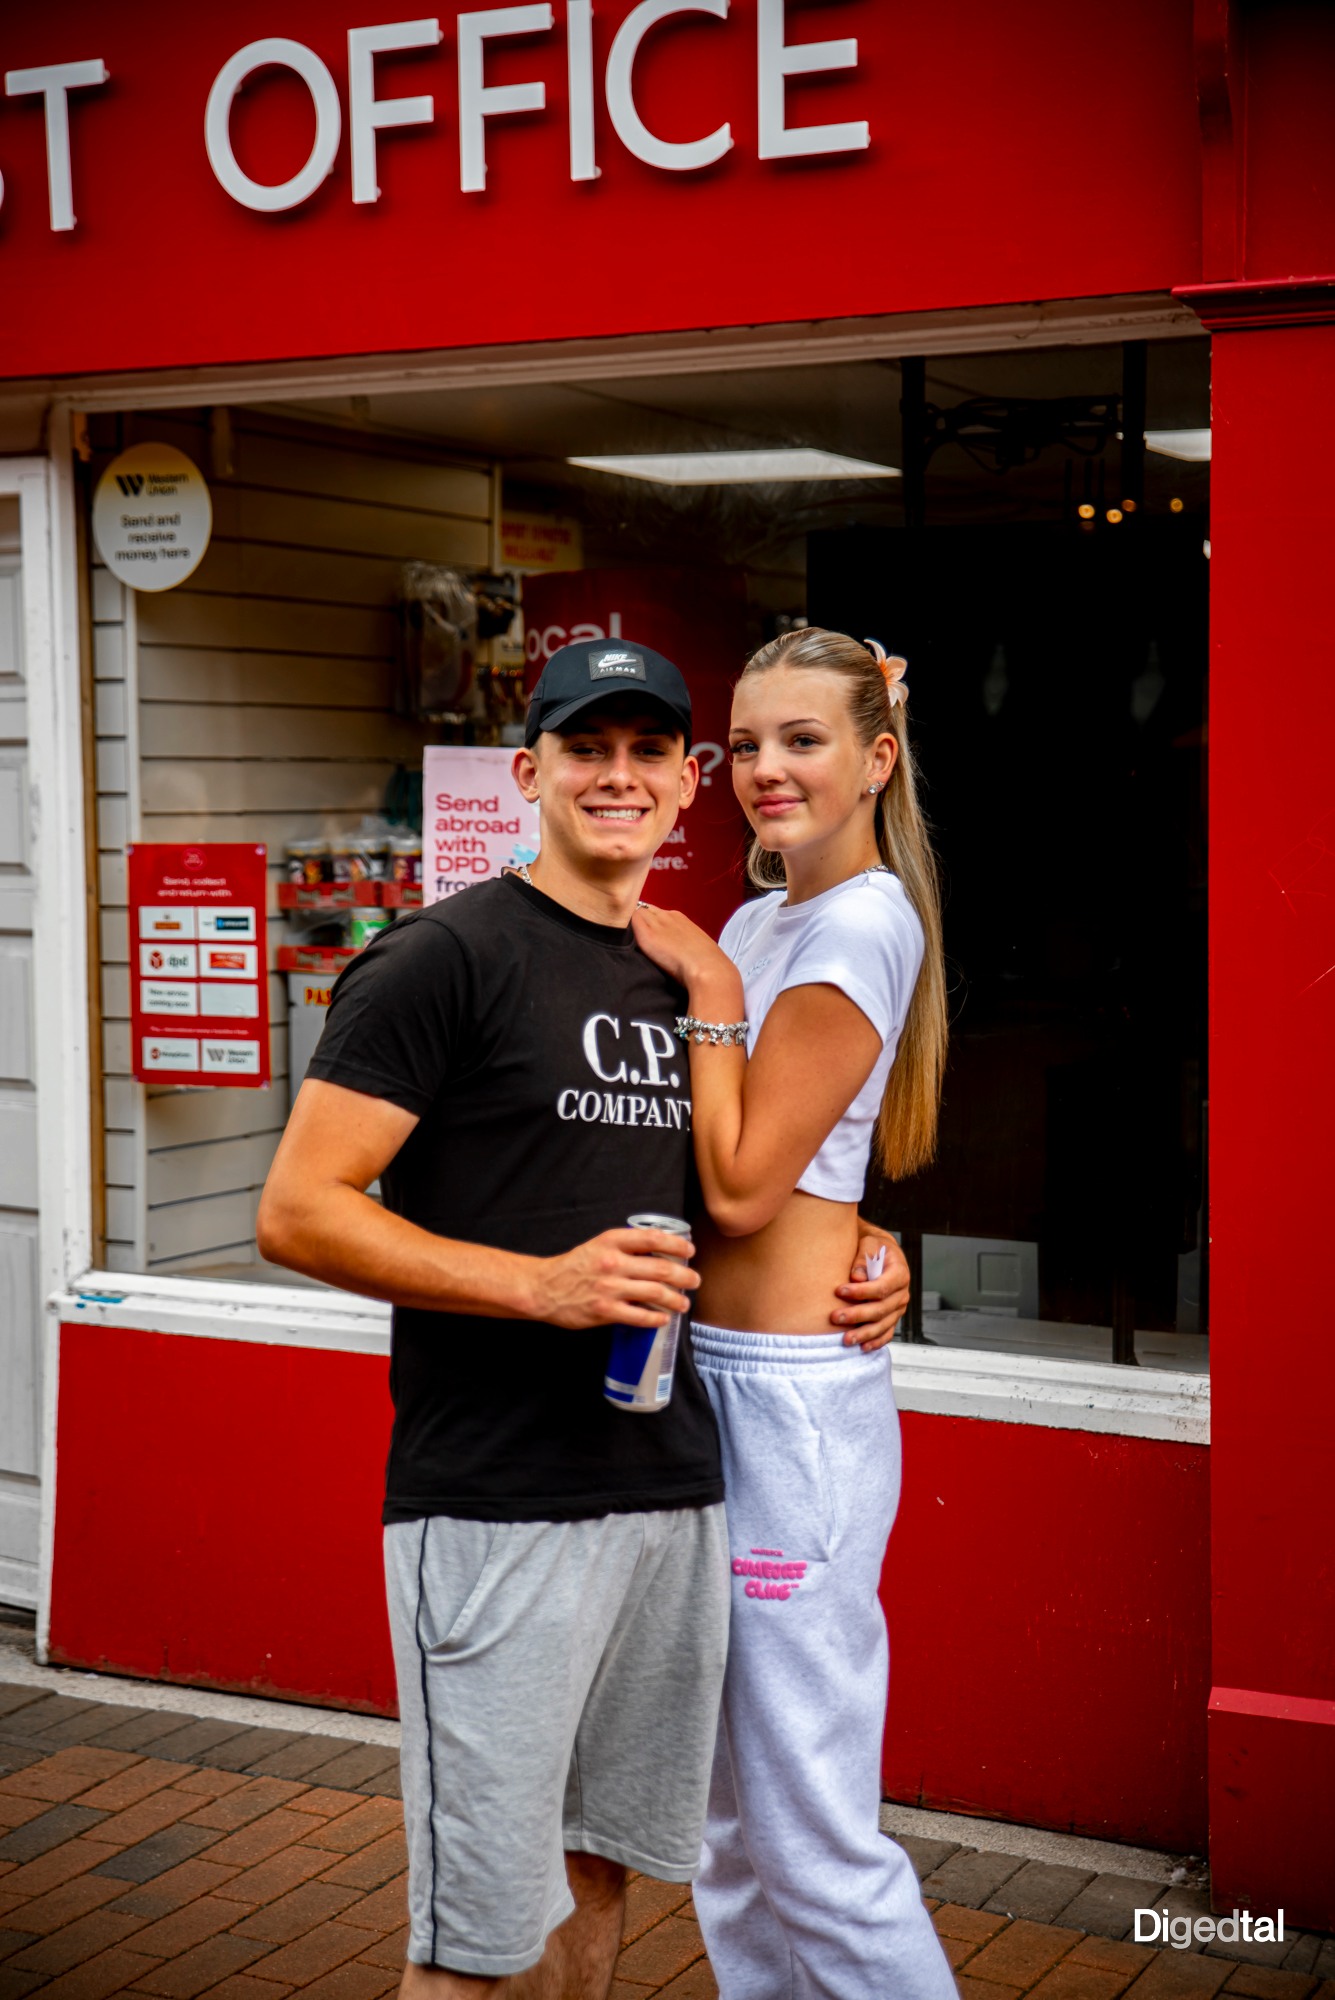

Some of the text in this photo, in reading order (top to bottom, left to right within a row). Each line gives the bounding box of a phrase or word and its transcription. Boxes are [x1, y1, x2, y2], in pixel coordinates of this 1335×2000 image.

[0, 0, 870, 232] T OFFICE
[121, 513, 180, 528] Send and
[128, 532, 176, 544] receive
[115, 548, 190, 562] money here
[603, 653, 628, 662] NIKE
[615, 666, 636, 674] MAX
[435, 793, 499, 813] Send
[434, 816, 520, 834] abroad
[435, 837, 486, 853] with
[435, 856, 490, 874] DPD
[651, 856, 689, 871] ere.
[435, 876, 478, 892] fro
[583, 1013, 681, 1089] C.P.
